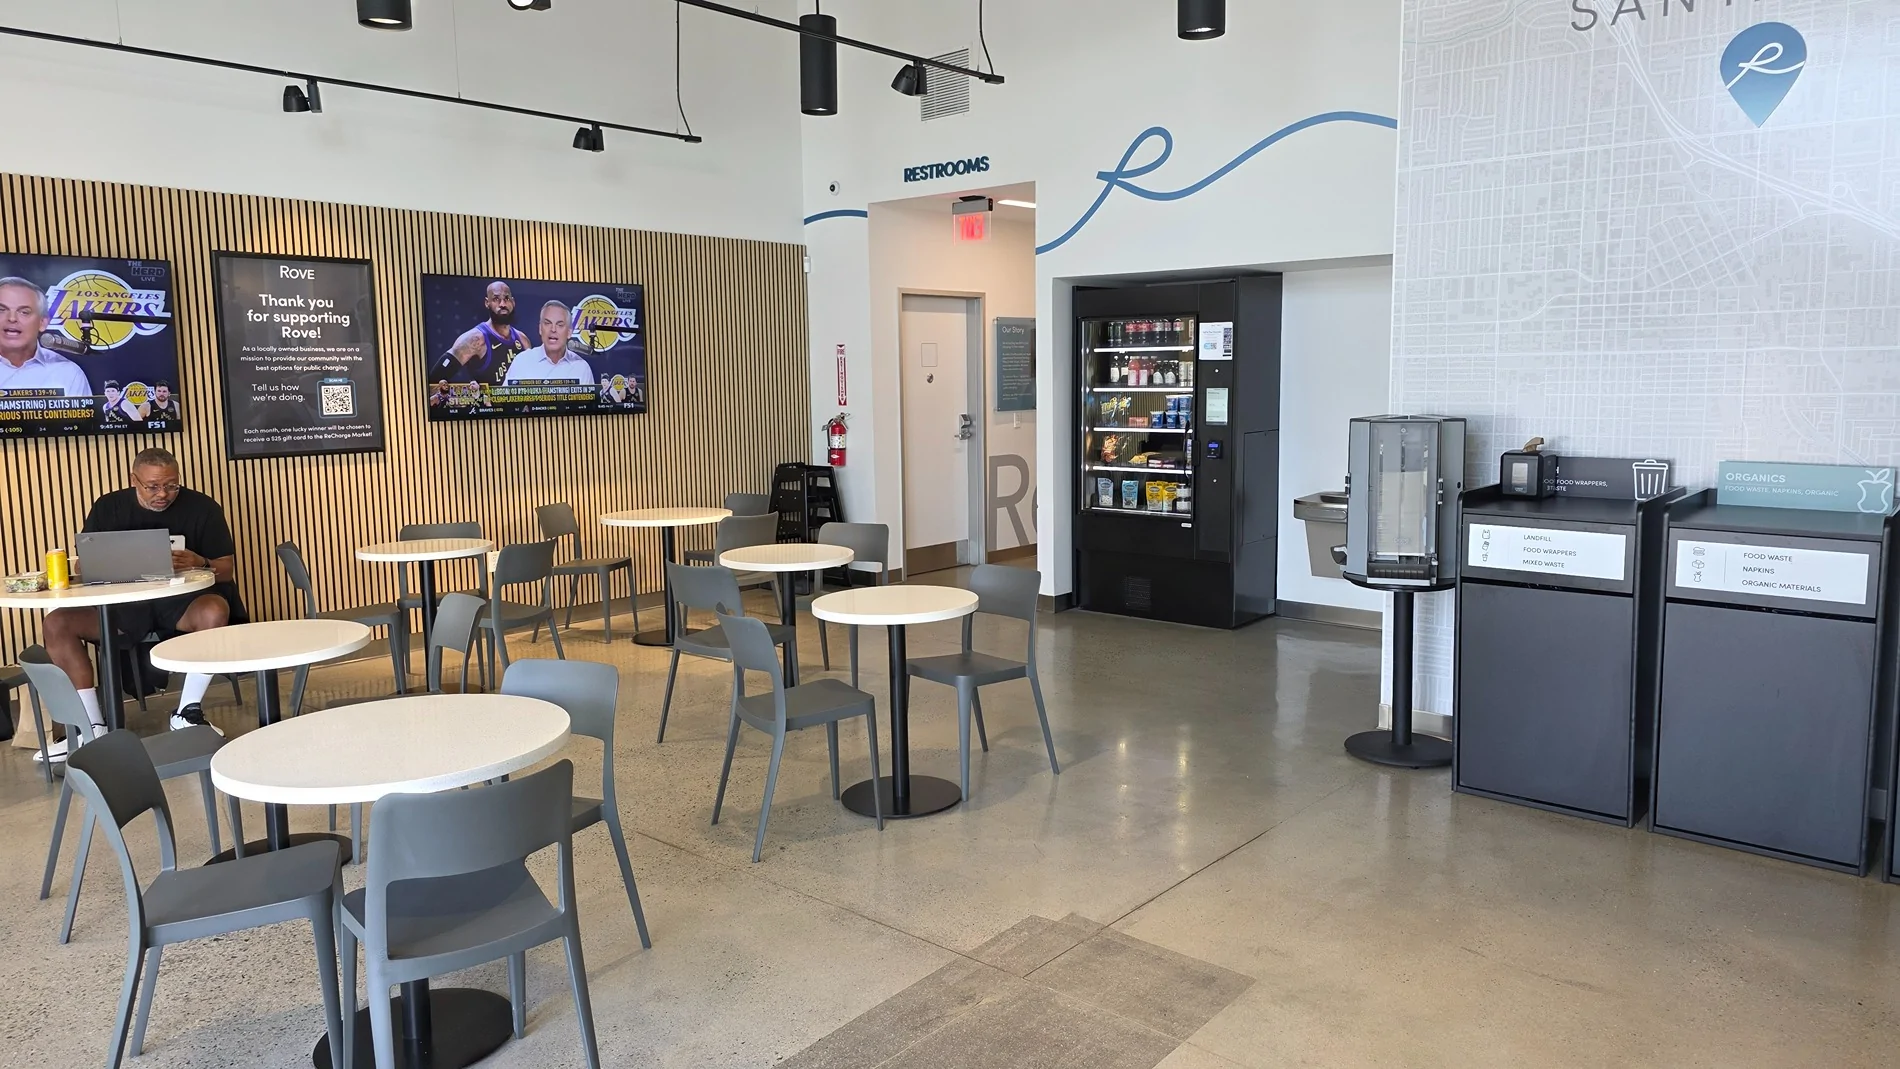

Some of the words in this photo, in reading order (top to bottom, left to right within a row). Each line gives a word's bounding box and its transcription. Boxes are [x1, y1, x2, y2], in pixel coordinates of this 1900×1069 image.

[903, 155, 990, 183] RESTROOMS
[132, 267, 165, 277] HERD
[102, 292, 161, 300] ANGELES
[258, 293, 305, 308] Thank
[308, 299, 334, 311] you
[247, 309, 269, 322] for
[273, 311, 350, 327] supporting
[281, 326, 321, 338] Rove!
[1012, 326, 1024, 334] Story
[251, 384, 267, 392] Tell
[281, 383, 300, 391] how
[278, 393, 306, 402] doing.
[48, 400, 70, 409] EXITS
[71, 399, 79, 408] IN
[81, 399, 94, 408] 3RD
[22, 410, 43, 419] TITLE
[44, 409, 94, 419] CONTENDERS?
[147, 421, 166, 429] FS1
[324, 432, 351, 440] ReCharge
[1725, 472, 1786, 483] ORGANICS
[1746, 486, 1770, 494] WASTE,
[1772, 488, 1803, 496] NAPKINS,
[1805, 489, 1838, 497] ORGANIC
[989, 454, 1037, 552] R
[1523, 534, 1552, 542] LANDFILL
[1543, 549, 1577, 557] WRAPPERS
[1743, 552, 1766, 560] FOOD
[1767, 554, 1793, 563] WASTE
[1523, 559, 1543, 567] MIXED
[1544, 561, 1565, 569] WASTE
[1742, 566, 1775, 575] NAPKINS
[1742, 579, 1777, 589] ORGANIC
[1779, 583, 1822, 593] MATERIALS
